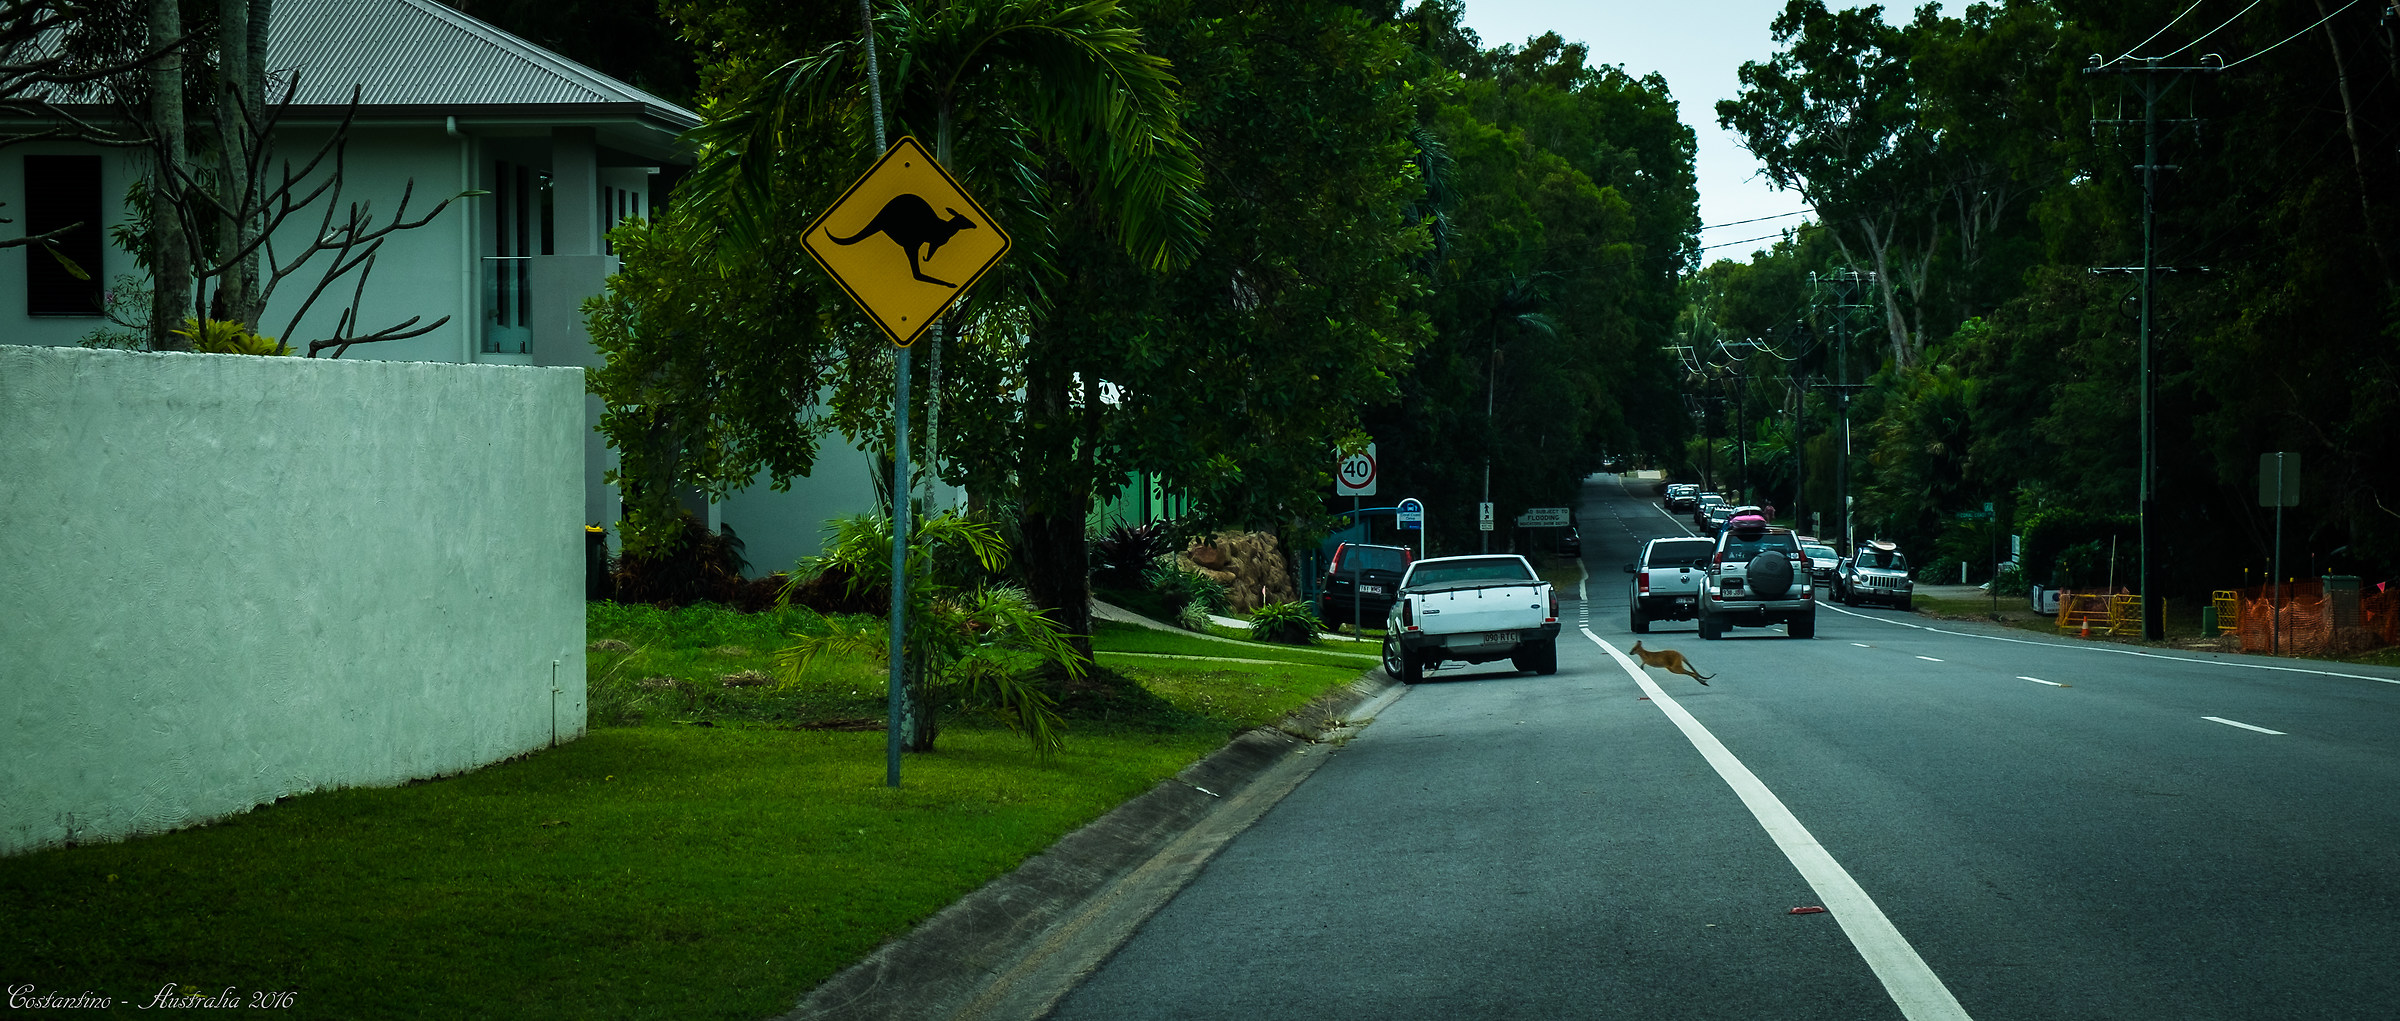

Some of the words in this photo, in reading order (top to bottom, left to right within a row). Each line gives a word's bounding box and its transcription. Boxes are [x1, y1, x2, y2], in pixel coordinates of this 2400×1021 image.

[1343, 460, 1368, 478] 40
[1485, 633, 1498, 642] 090
[1500, 632, 1515, 641] RTC
